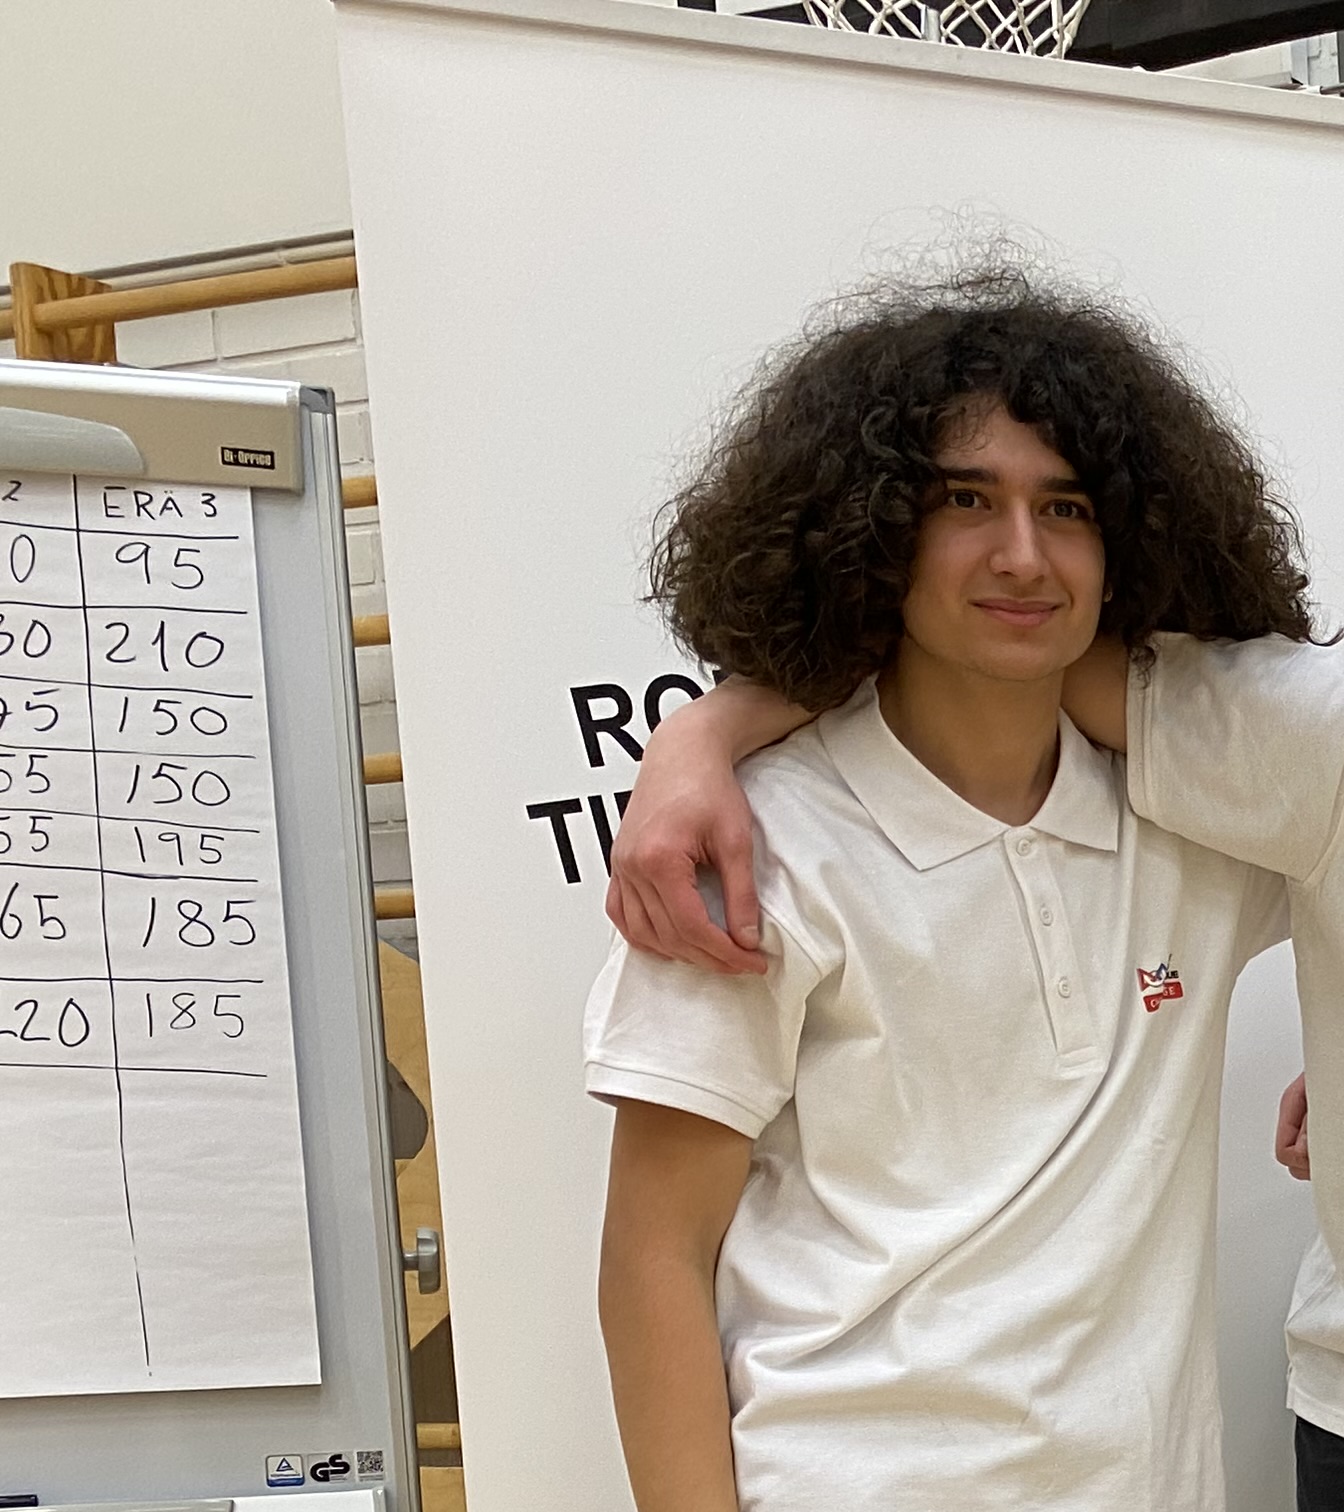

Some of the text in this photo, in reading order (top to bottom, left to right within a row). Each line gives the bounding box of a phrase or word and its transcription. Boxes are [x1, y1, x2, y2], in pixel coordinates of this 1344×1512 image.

[103, 486, 218, 521] ERÄ 3
[115, 541, 204, 590] 95
[105, 619, 225, 674] 210
[118, 695, 228, 736] 150
[126, 762, 231, 807] 150
[134, 826, 225, 866] 195
[143, 896, 256, 948] 185
[0, 998, 89, 1048] 20
[146, 992, 244, 1038] 185
[310, 1453, 351, 1483] GS
